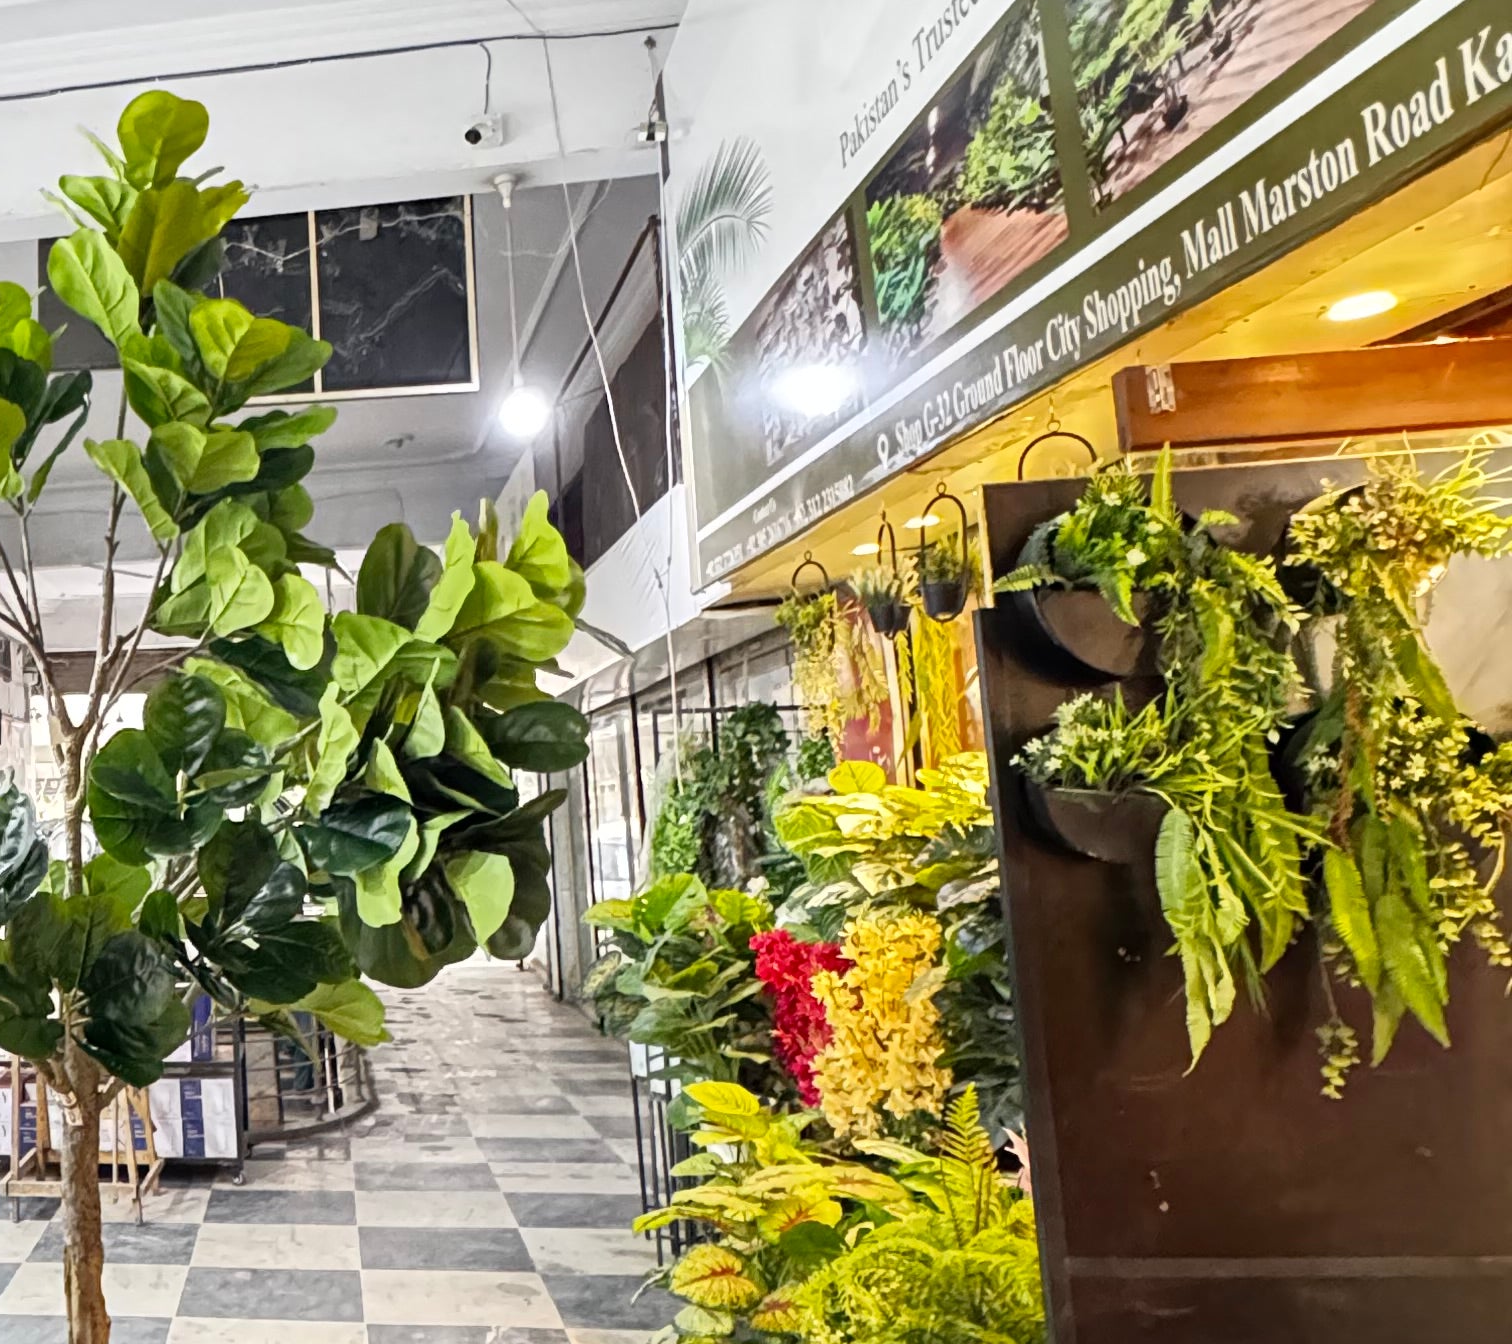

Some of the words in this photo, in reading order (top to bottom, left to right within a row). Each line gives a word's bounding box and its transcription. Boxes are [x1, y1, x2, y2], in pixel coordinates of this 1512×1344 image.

[839, 58, 912, 169] Pakistan's
[923, 391, 953, 443] G-32
[953, 359, 1004, 420] Ground
[1003, 339, 1045, 389] Floor
[1045, 312, 1082, 360] City
[1082, 256, 1182, 339] Shopping,
[1180, 201, 1239, 280] Mall
[1238, 137, 1360, 244] Marston
[1360, 56, 1455, 167] Road
